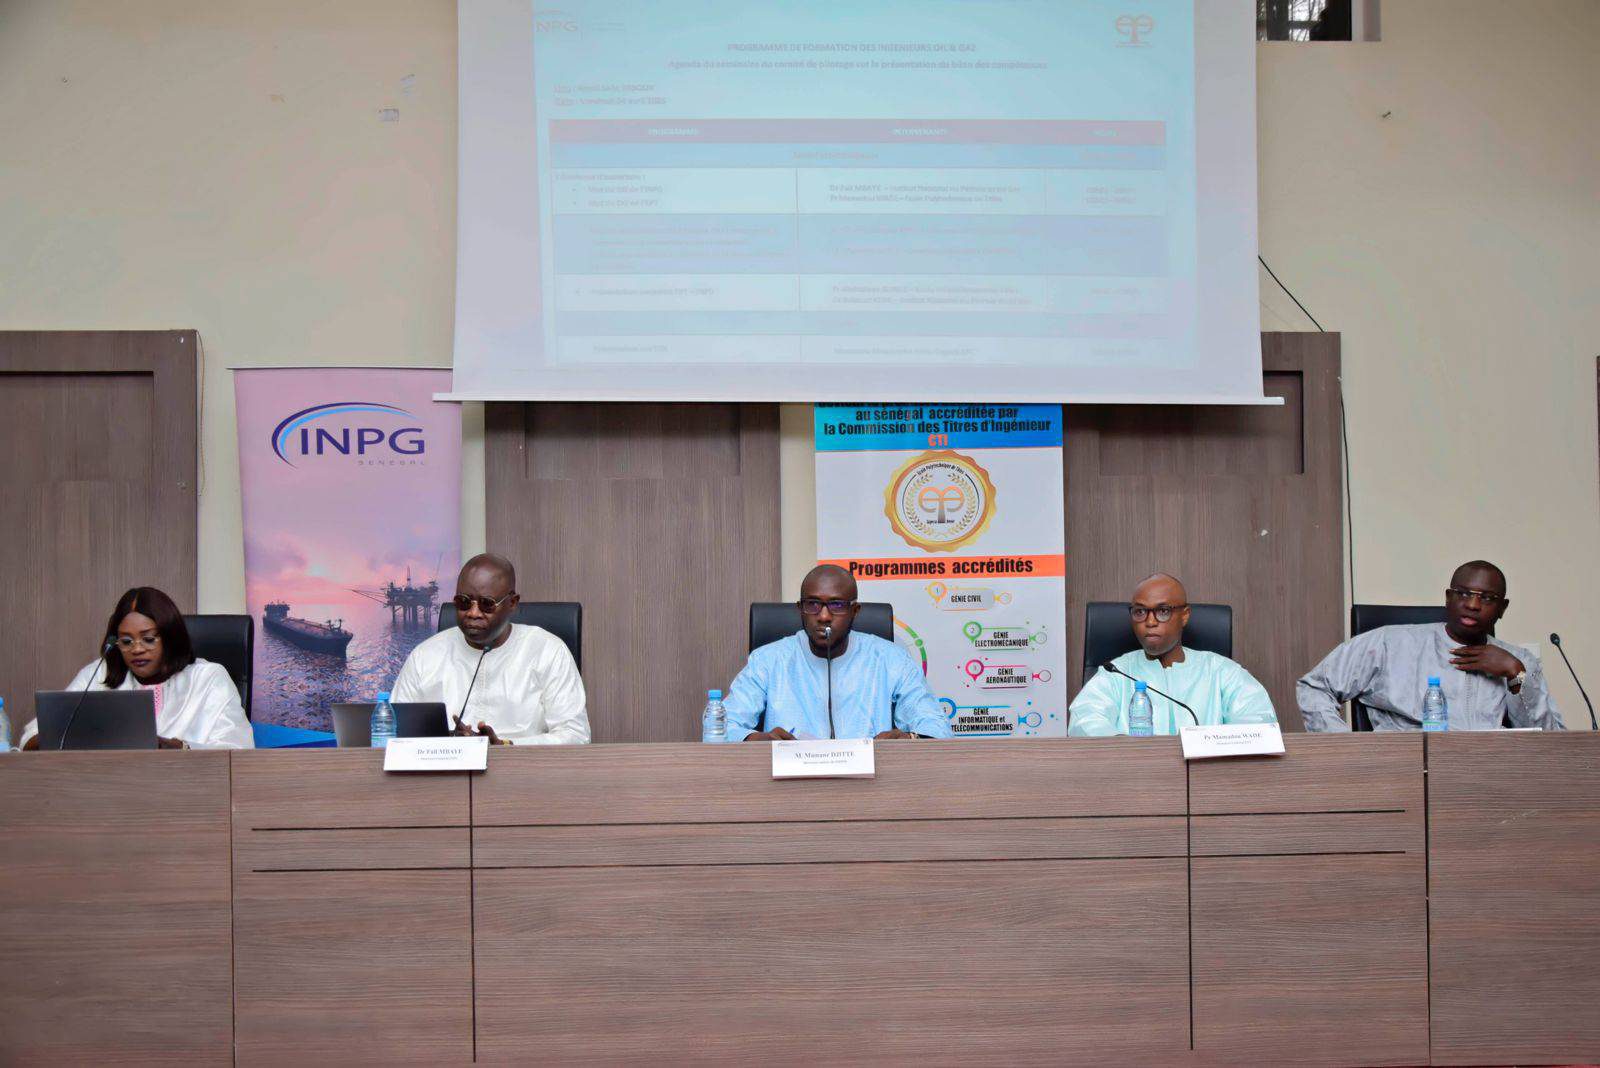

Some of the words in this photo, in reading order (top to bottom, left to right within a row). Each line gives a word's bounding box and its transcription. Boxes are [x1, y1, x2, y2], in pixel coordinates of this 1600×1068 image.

[856, 410, 871, 421] au
[874, 407, 924, 421] sénégal
[928, 405, 996, 419] accréditée
[998, 407, 1020, 419] par
[824, 423, 836, 435] la
[839, 422, 915, 435] Commission
[917, 421, 941, 433] des
[943, 419, 979, 433] Titres
[981, 417, 1052, 433] d'Ingénieur
[300, 427, 426, 456] INPG
[928, 433, 948, 447] CTI
[849, 561, 946, 577] Programmes
[952, 557, 1034, 574] accrédités
[958, 715, 999, 724] INFORMATIQUE
